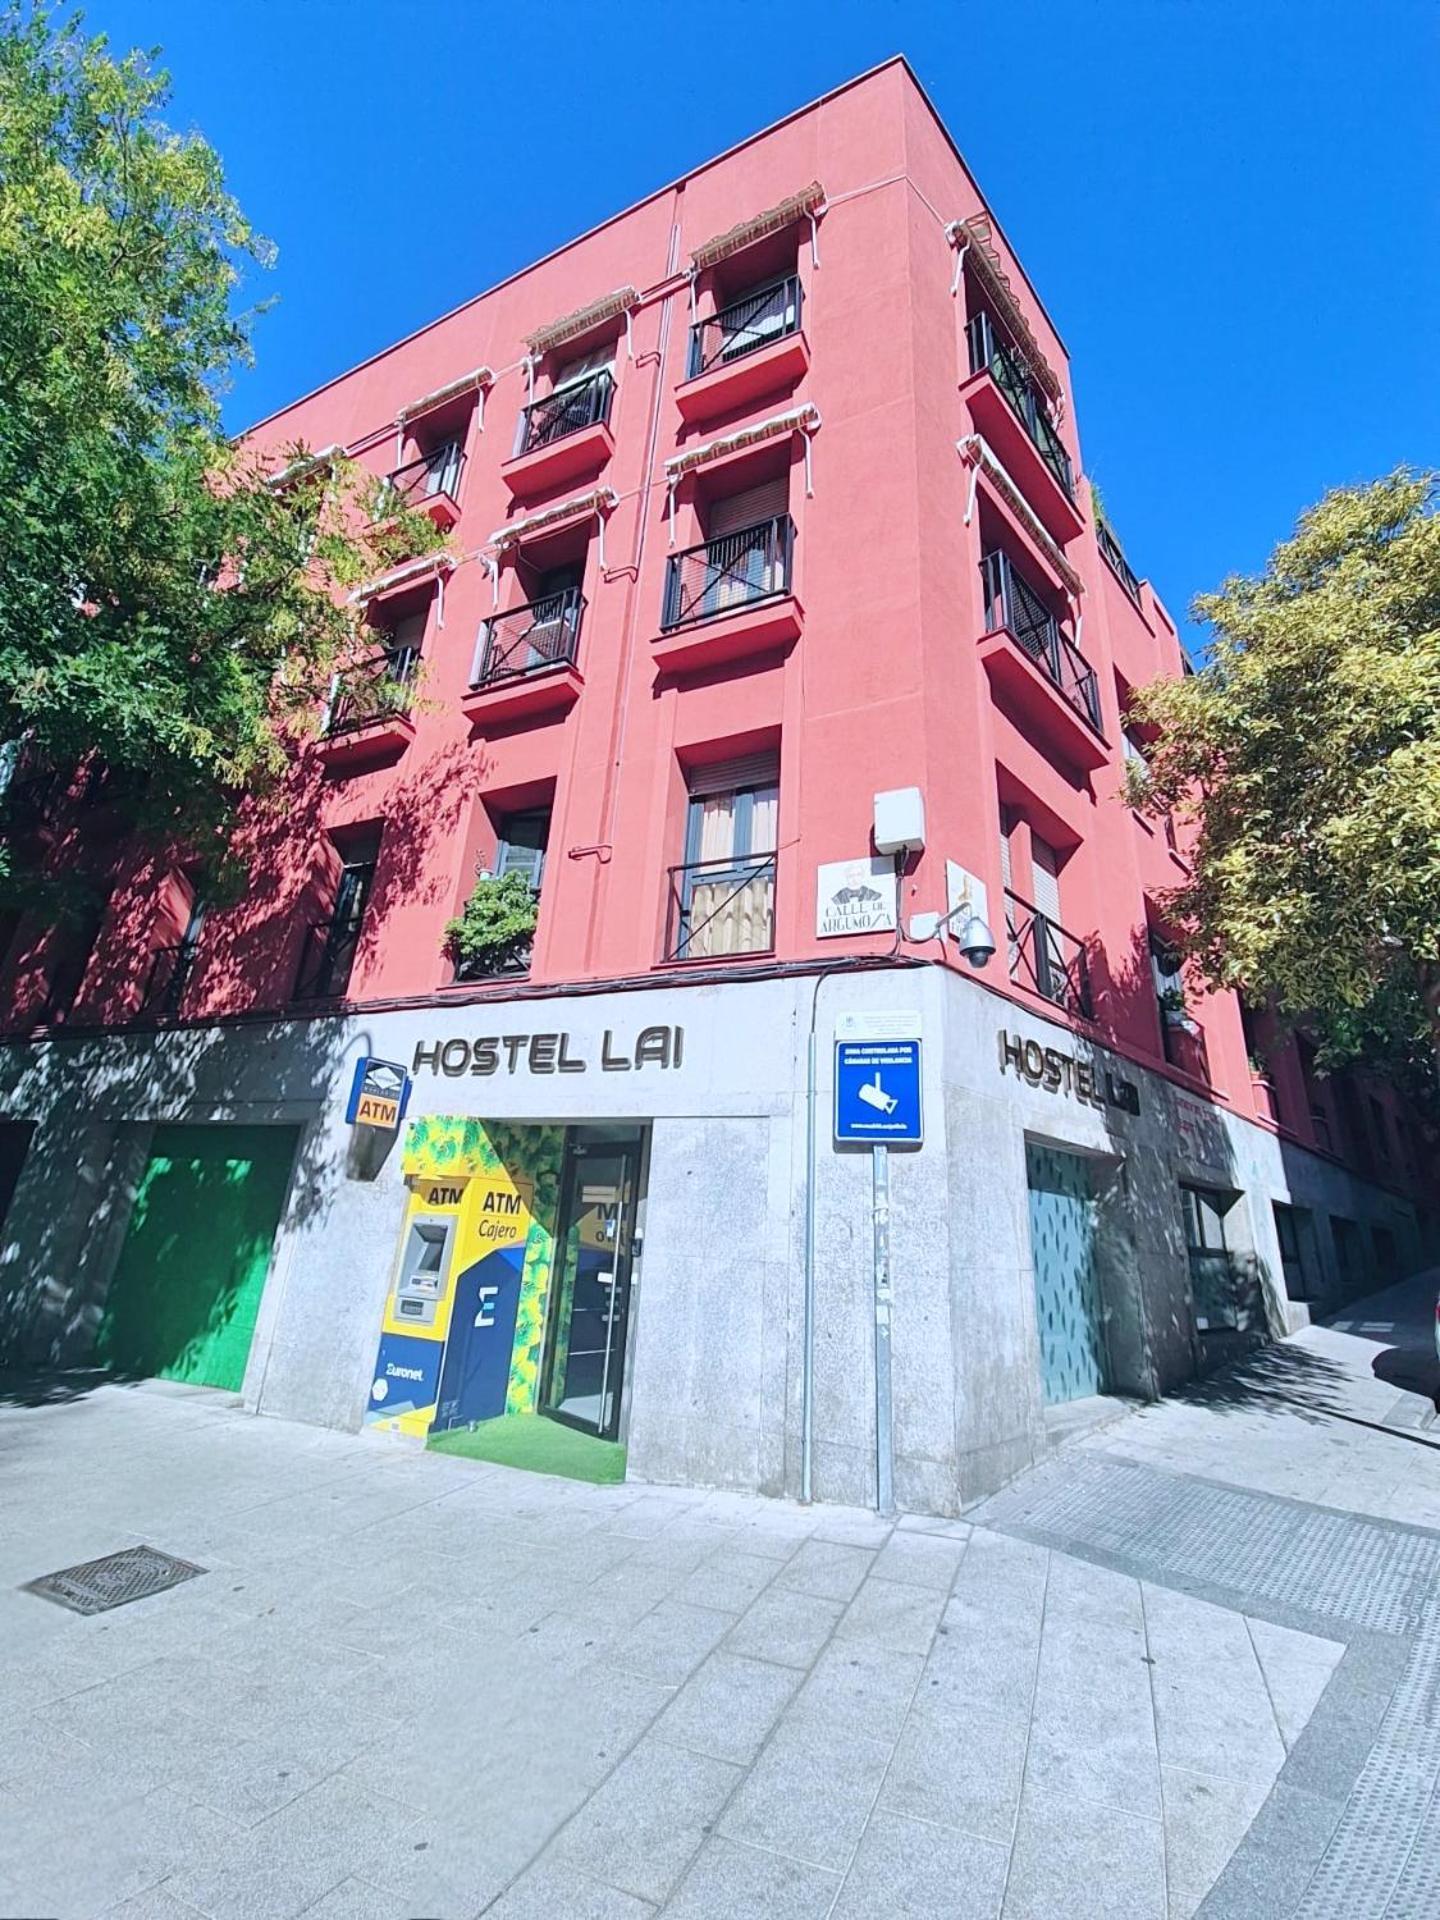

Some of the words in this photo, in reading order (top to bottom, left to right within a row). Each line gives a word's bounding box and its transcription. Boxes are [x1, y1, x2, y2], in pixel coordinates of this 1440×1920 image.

[825, 902, 867, 918] CALLE
[820, 912, 892, 933] ARGUMOZA
[412, 1032, 586, 1077] HOSTEL
[601, 1024, 685, 1071] LAI
[997, 1028, 1106, 1112] HOSTEL
[359, 1100, 397, 1122] ATM
[428, 1187, 464, 1206] ATM
[483, 1191, 522, 1215] ATM
[478, 1219, 517, 1241] Cajero
[385, 1362, 424, 1382] Euronet
